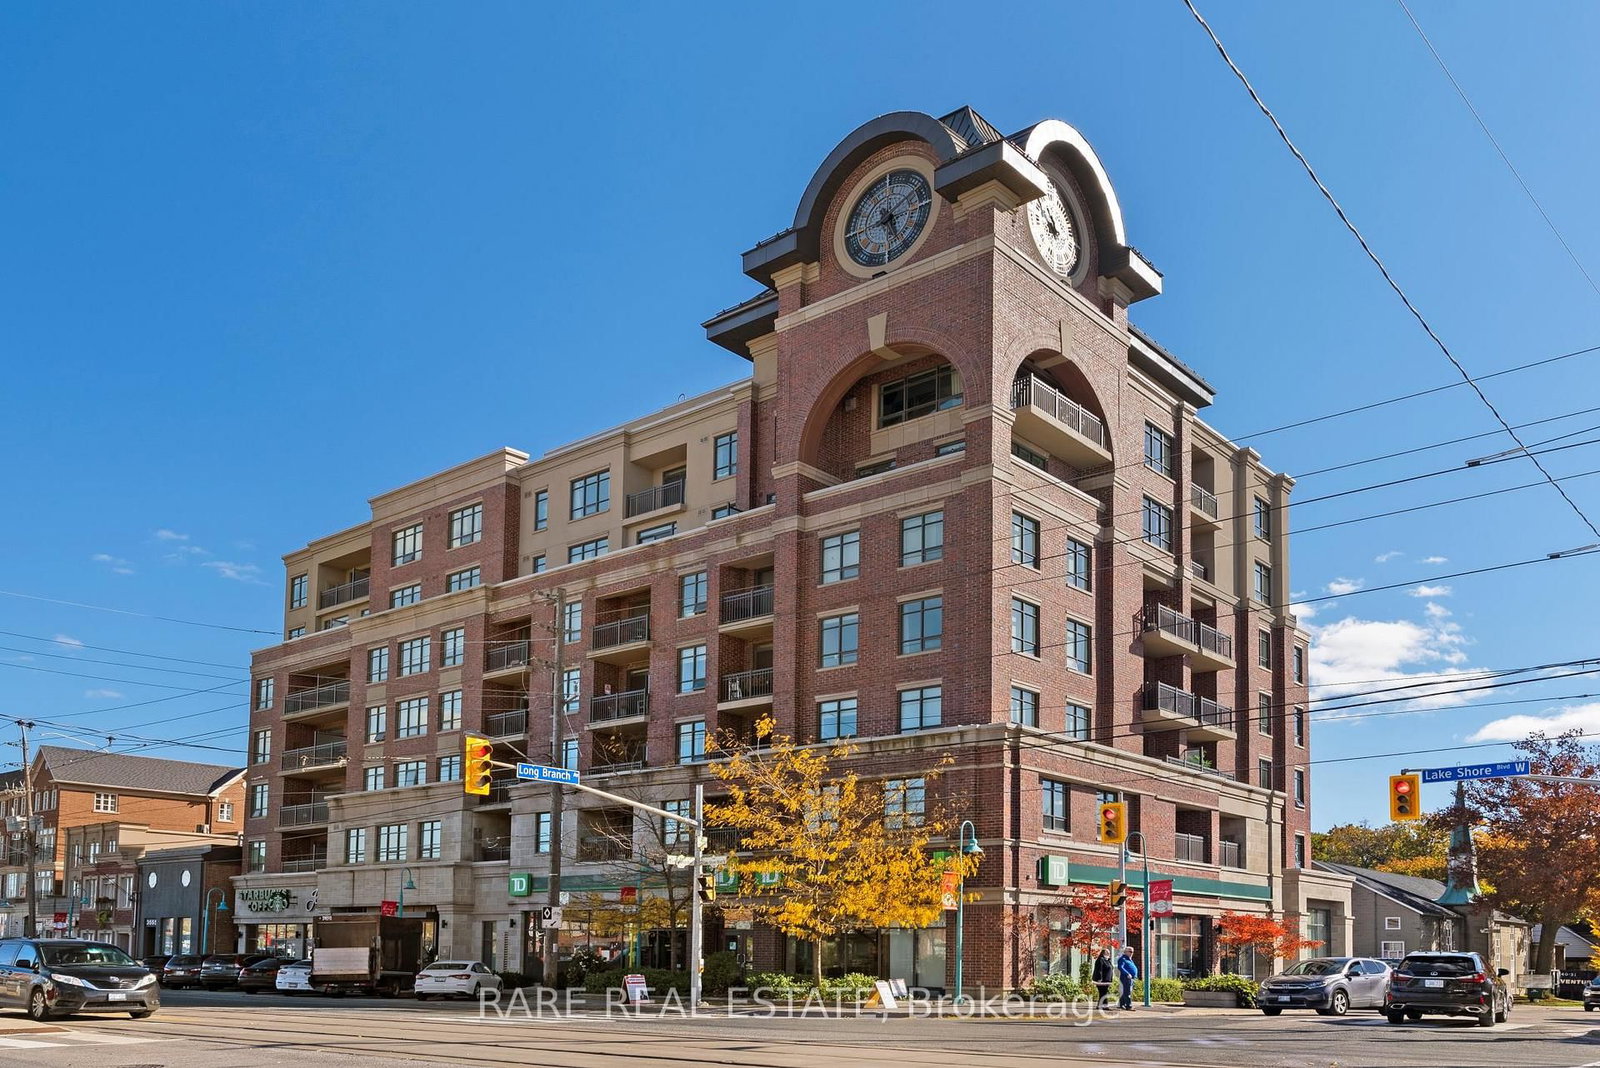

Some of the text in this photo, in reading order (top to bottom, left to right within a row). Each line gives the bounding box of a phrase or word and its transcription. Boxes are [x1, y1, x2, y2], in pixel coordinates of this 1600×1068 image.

[519, 764, 539, 778] Long
[542, 767, 571, 780] Branch
[1425, 770, 1452, 780] Lake
[1457, 766, 1492, 778] Shore
[1514, 762, 1526, 773] W
[1051, 861, 1066, 880] TD
[511, 877, 526, 892] TD
